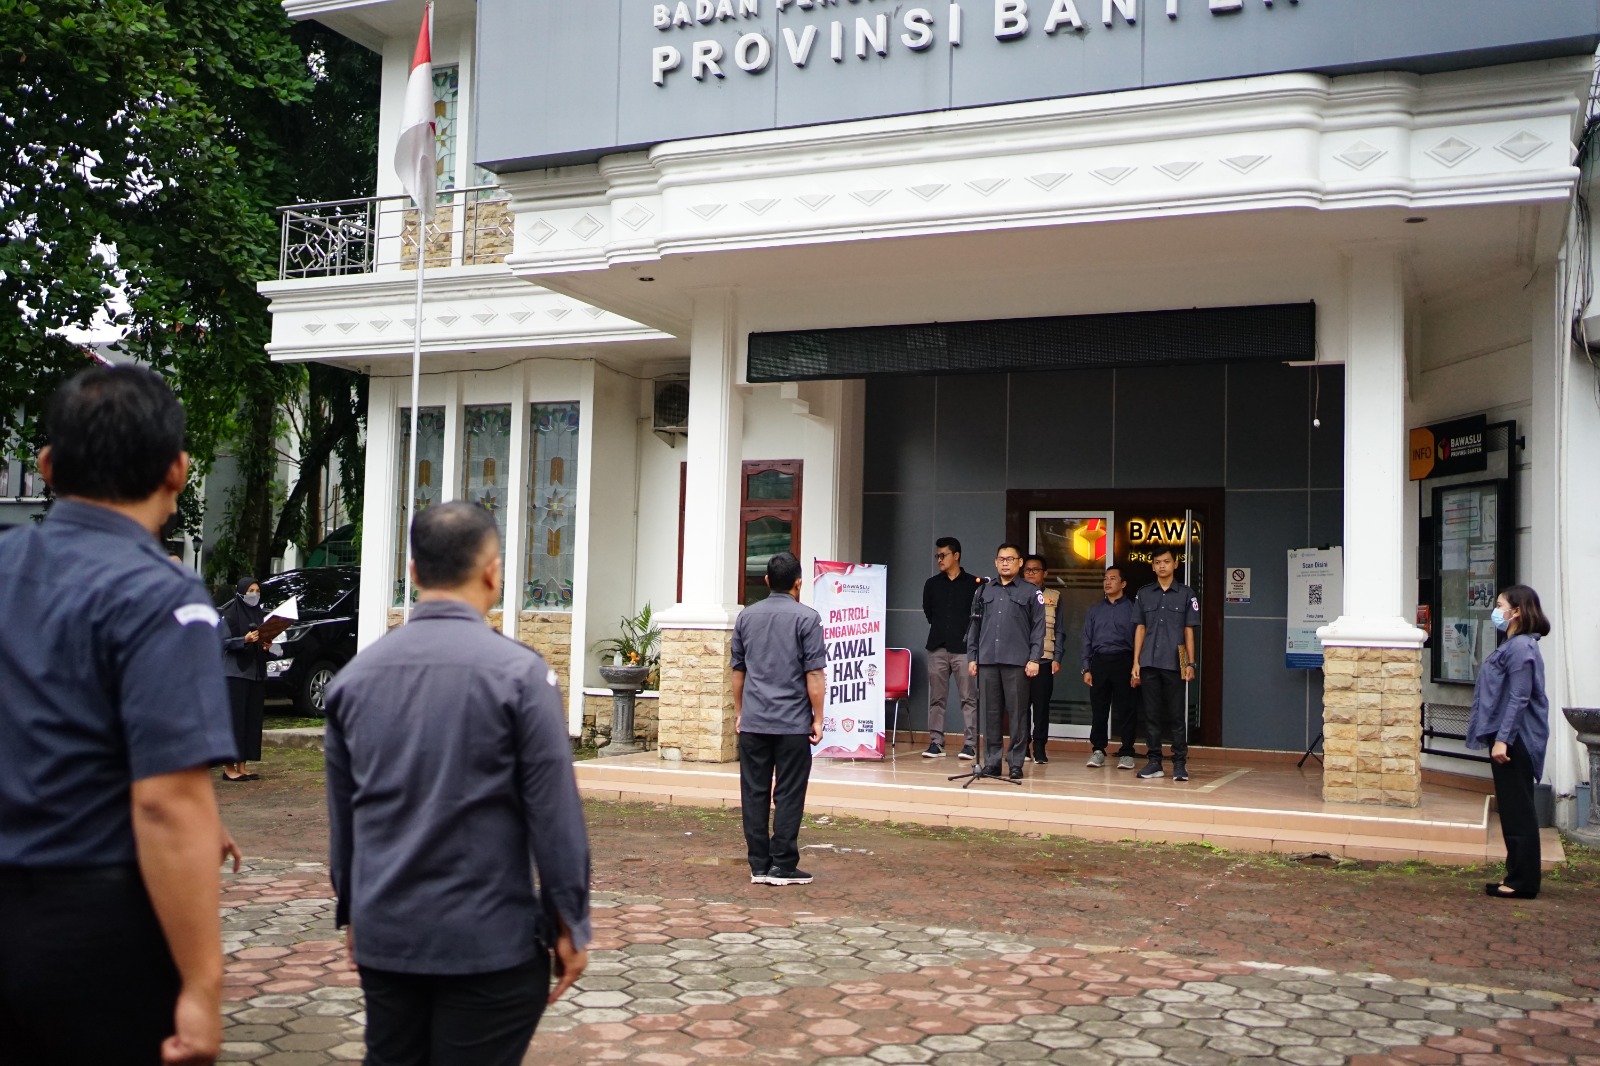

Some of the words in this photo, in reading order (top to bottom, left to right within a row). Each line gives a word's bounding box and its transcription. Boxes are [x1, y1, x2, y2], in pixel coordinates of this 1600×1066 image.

[653, 0, 758, 30] BADAN
[652, 3, 961, 87] PROVINSI
[1450, 433, 1482, 448] BAWASLU
[1412, 446, 1432, 461] INFO
[823, 621, 880, 640] ENGAWASAN
[823, 638, 875, 661] KAWAL
[833, 660, 864, 682] HAK
[830, 681, 866, 705] PILIH
